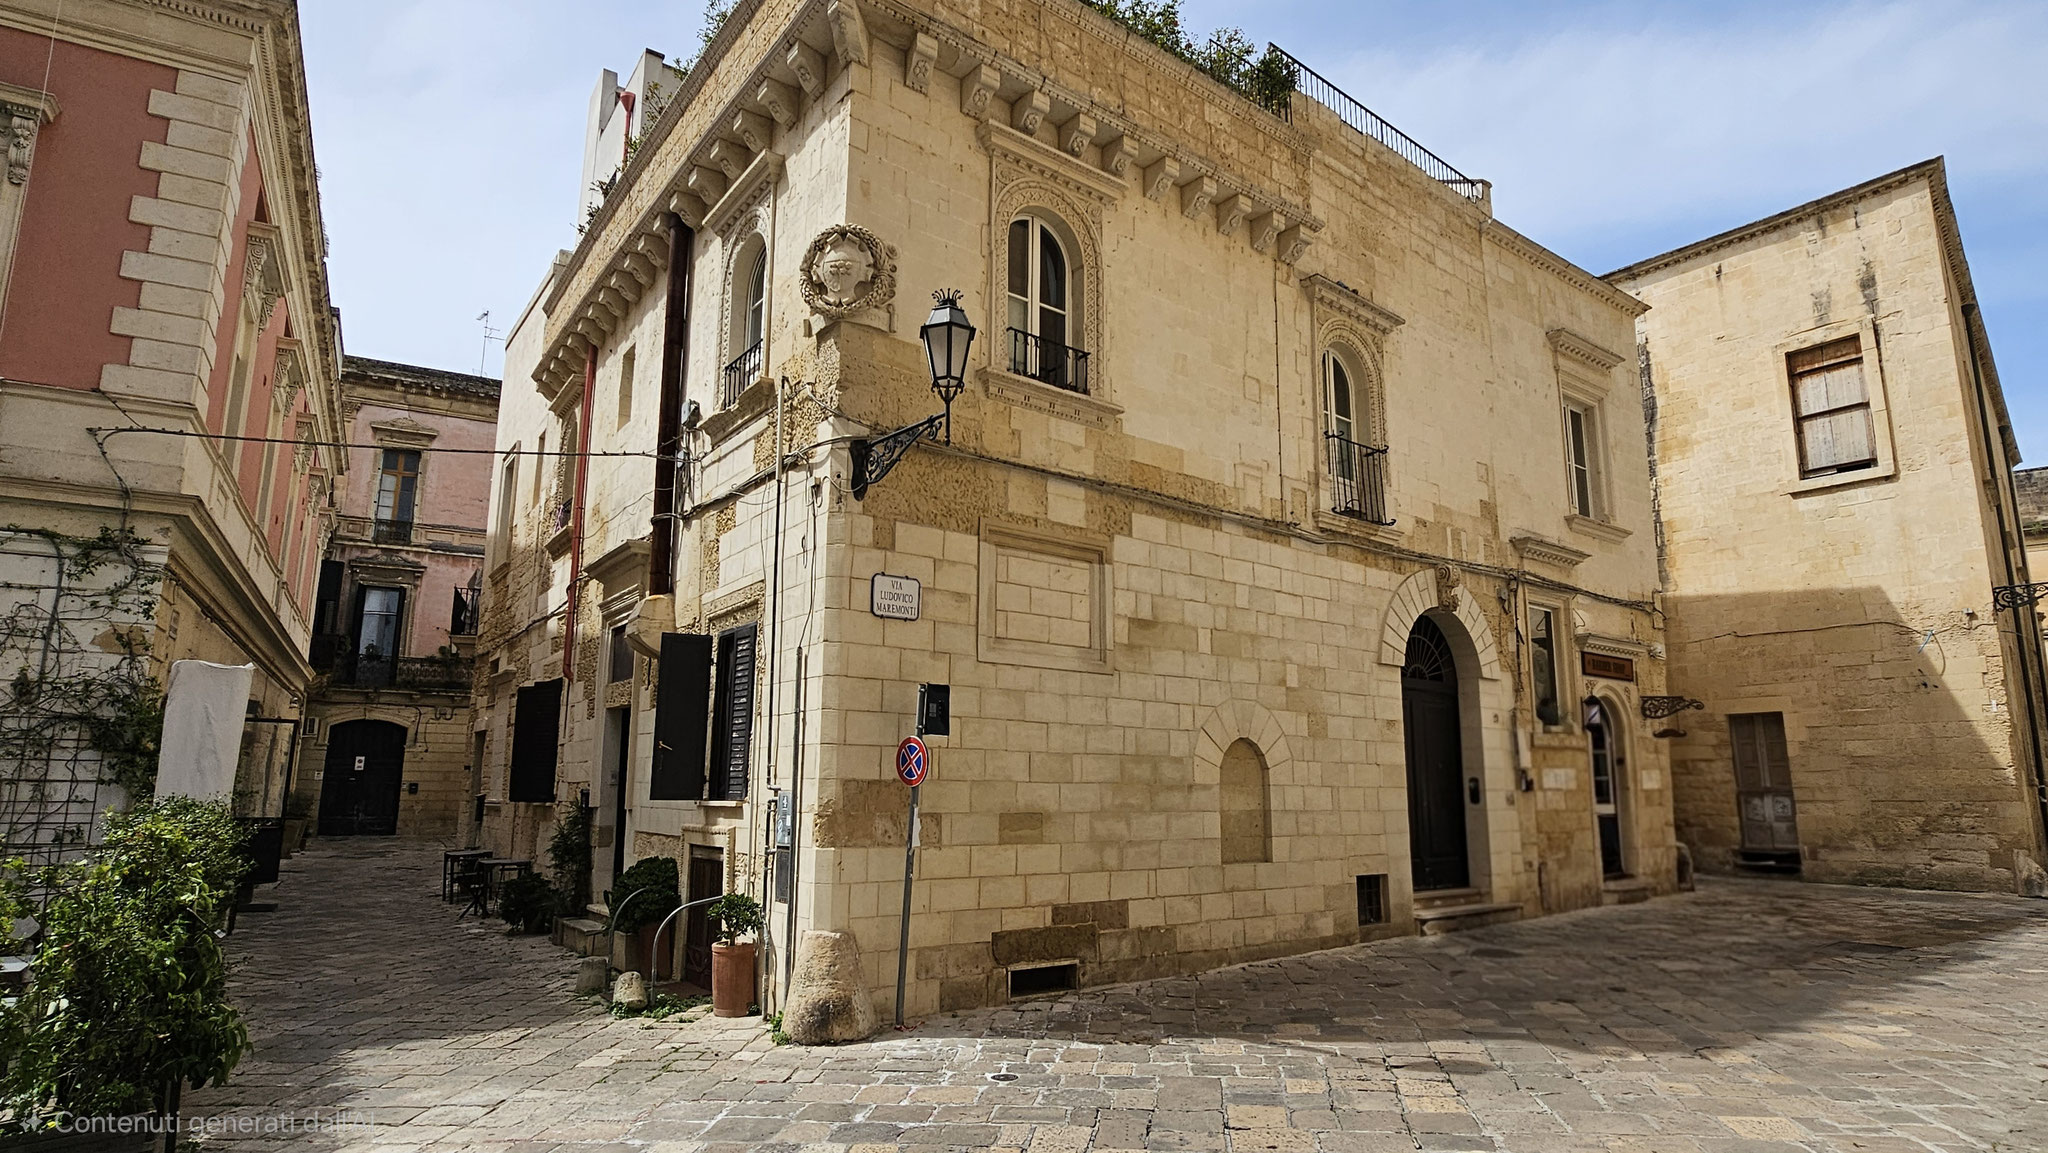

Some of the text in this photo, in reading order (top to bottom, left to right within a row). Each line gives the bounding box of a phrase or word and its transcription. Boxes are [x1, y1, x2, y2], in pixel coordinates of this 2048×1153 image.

[891, 580, 903, 591] VIA
[880, 590, 914, 604] LUDOVICO
[876, 602, 916, 616] MAREMONTI
